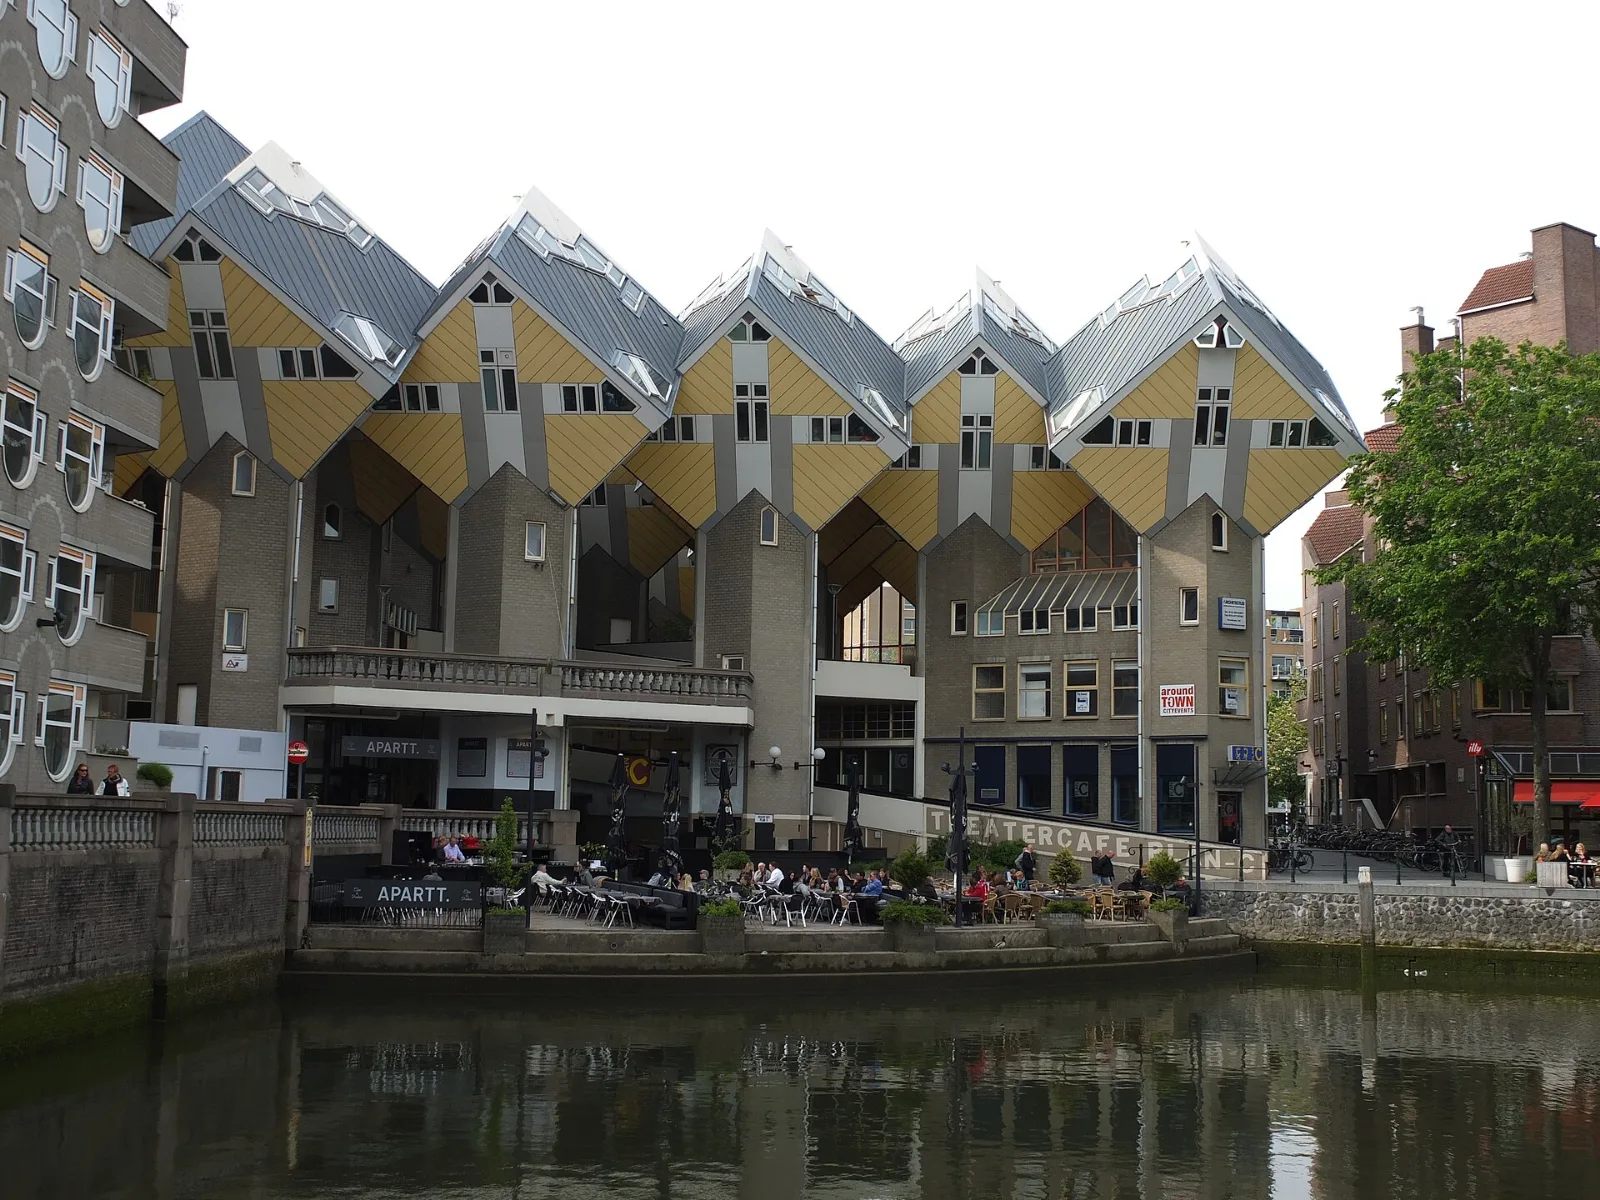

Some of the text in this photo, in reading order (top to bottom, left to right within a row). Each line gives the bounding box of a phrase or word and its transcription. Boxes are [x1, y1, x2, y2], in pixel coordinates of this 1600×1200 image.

[1161, 687, 1194, 696] around
[1161, 696, 1194, 708] TOWN
[1468, 742, 1482, 755] illy
[931, 811, 1130, 858] TEATERCAFE
[377, 886, 449, 902] APARTT.
